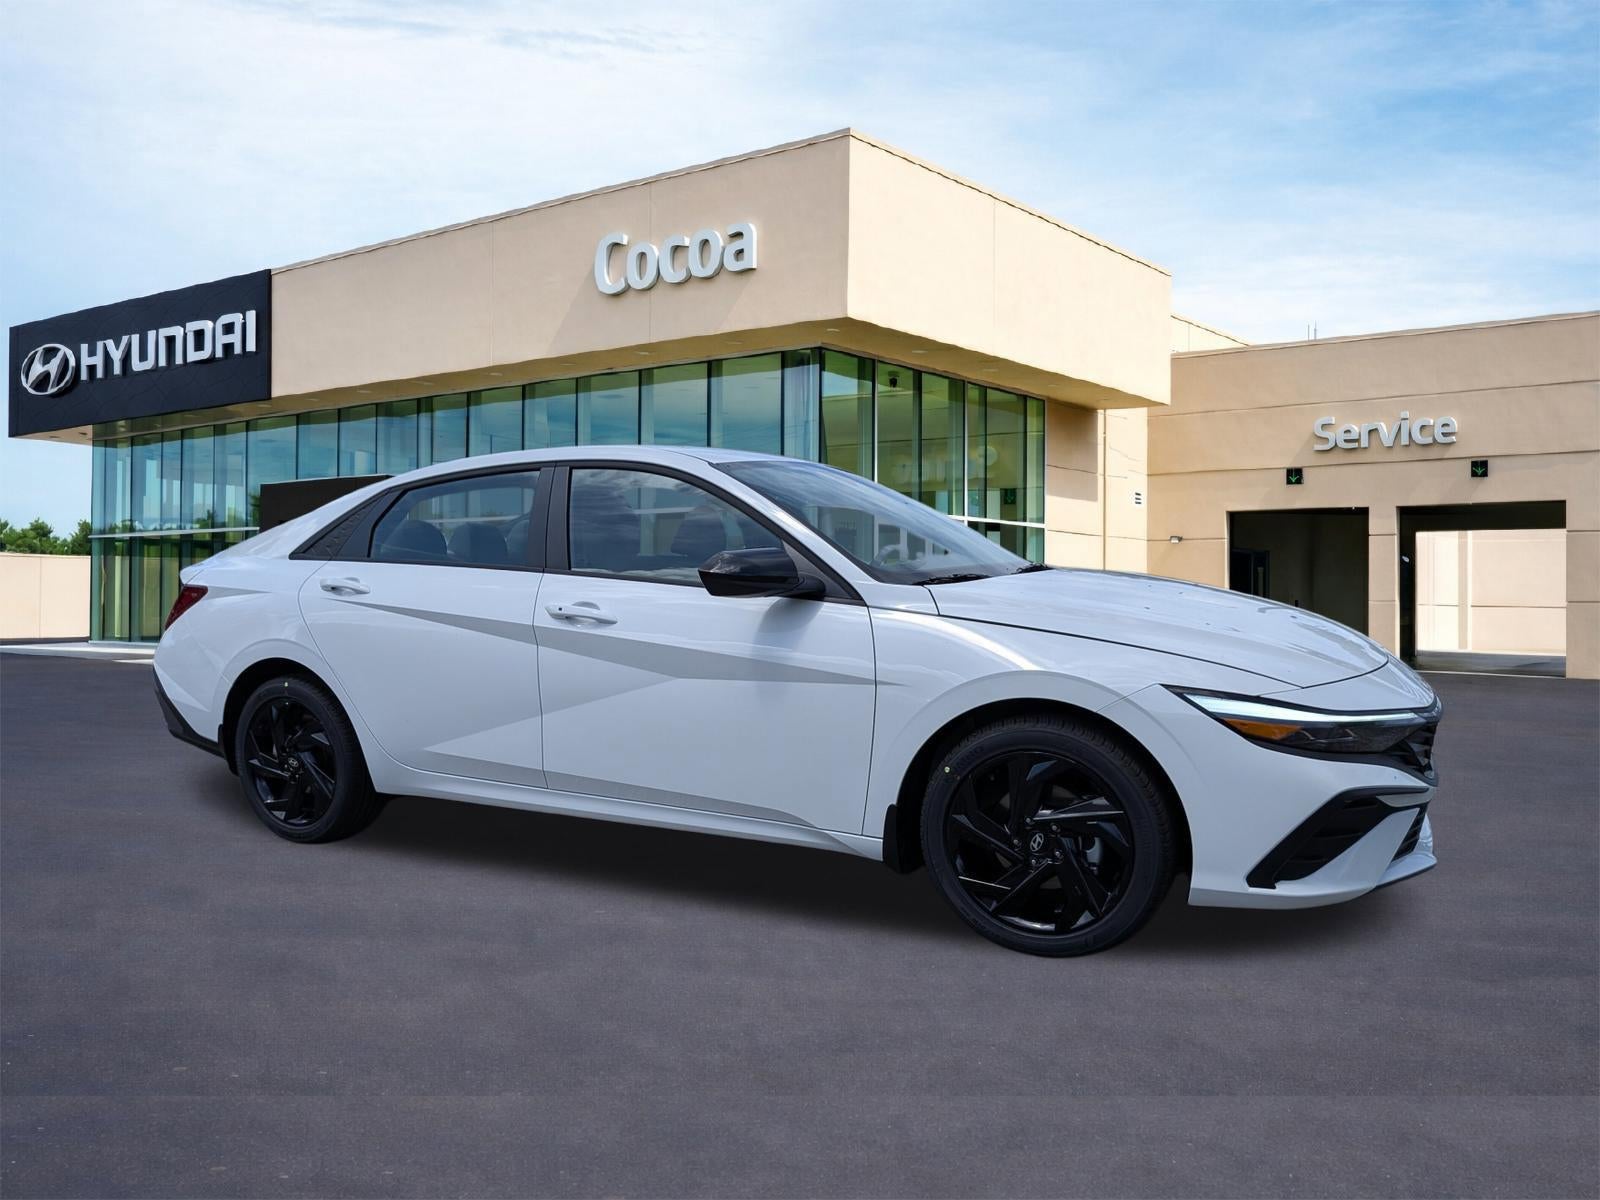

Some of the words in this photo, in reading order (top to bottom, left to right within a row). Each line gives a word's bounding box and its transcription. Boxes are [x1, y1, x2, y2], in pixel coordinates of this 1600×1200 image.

[594, 223, 757, 295] Cocoa
[80, 310, 257, 381] HYUNDAI
[1313, 411, 1458, 451] Service
